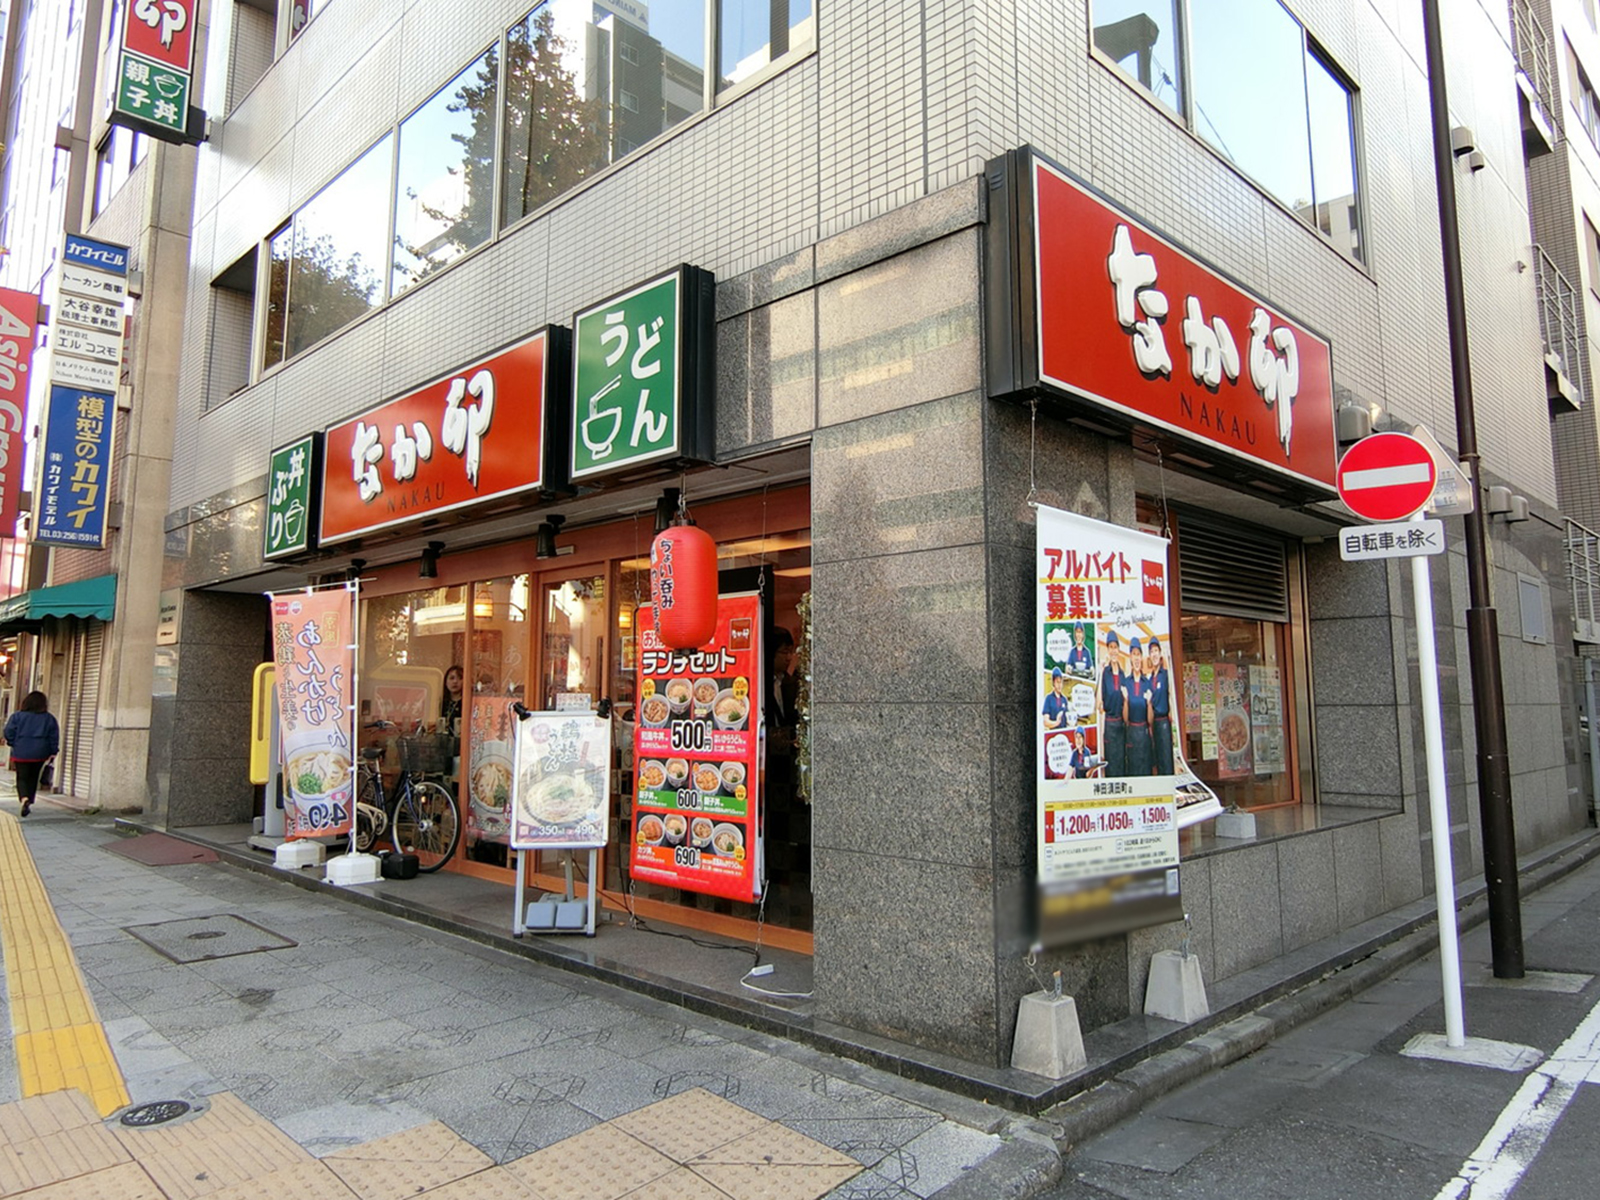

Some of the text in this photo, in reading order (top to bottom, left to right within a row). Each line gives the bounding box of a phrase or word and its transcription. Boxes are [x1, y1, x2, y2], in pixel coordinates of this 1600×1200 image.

[126, 60, 178, 124] 親子丼
[62, 272, 123, 294] トーカン商事
[66, 242, 125, 266] カワイビル
[1106, 222, 1300, 458] なか卯
[599, 309, 669, 448] うどん
[350, 368, 495, 504] なか卯
[1179, 390, 1257, 446] NAKAU
[66, 395, 106, 529] 模型のカワイ
[271, 449, 306, 549] 丼ぶり
[386, 480, 447, 515] NAKAU
[1043, 547, 1132, 584] アルバイト
[1345, 528, 1437, 554] 自転車を除く
[659, 538, 675, 610] ちょい呑み
[1059, 814, 1097, 836] 1,200円
[1099, 810, 1134, 833] 1,050円
